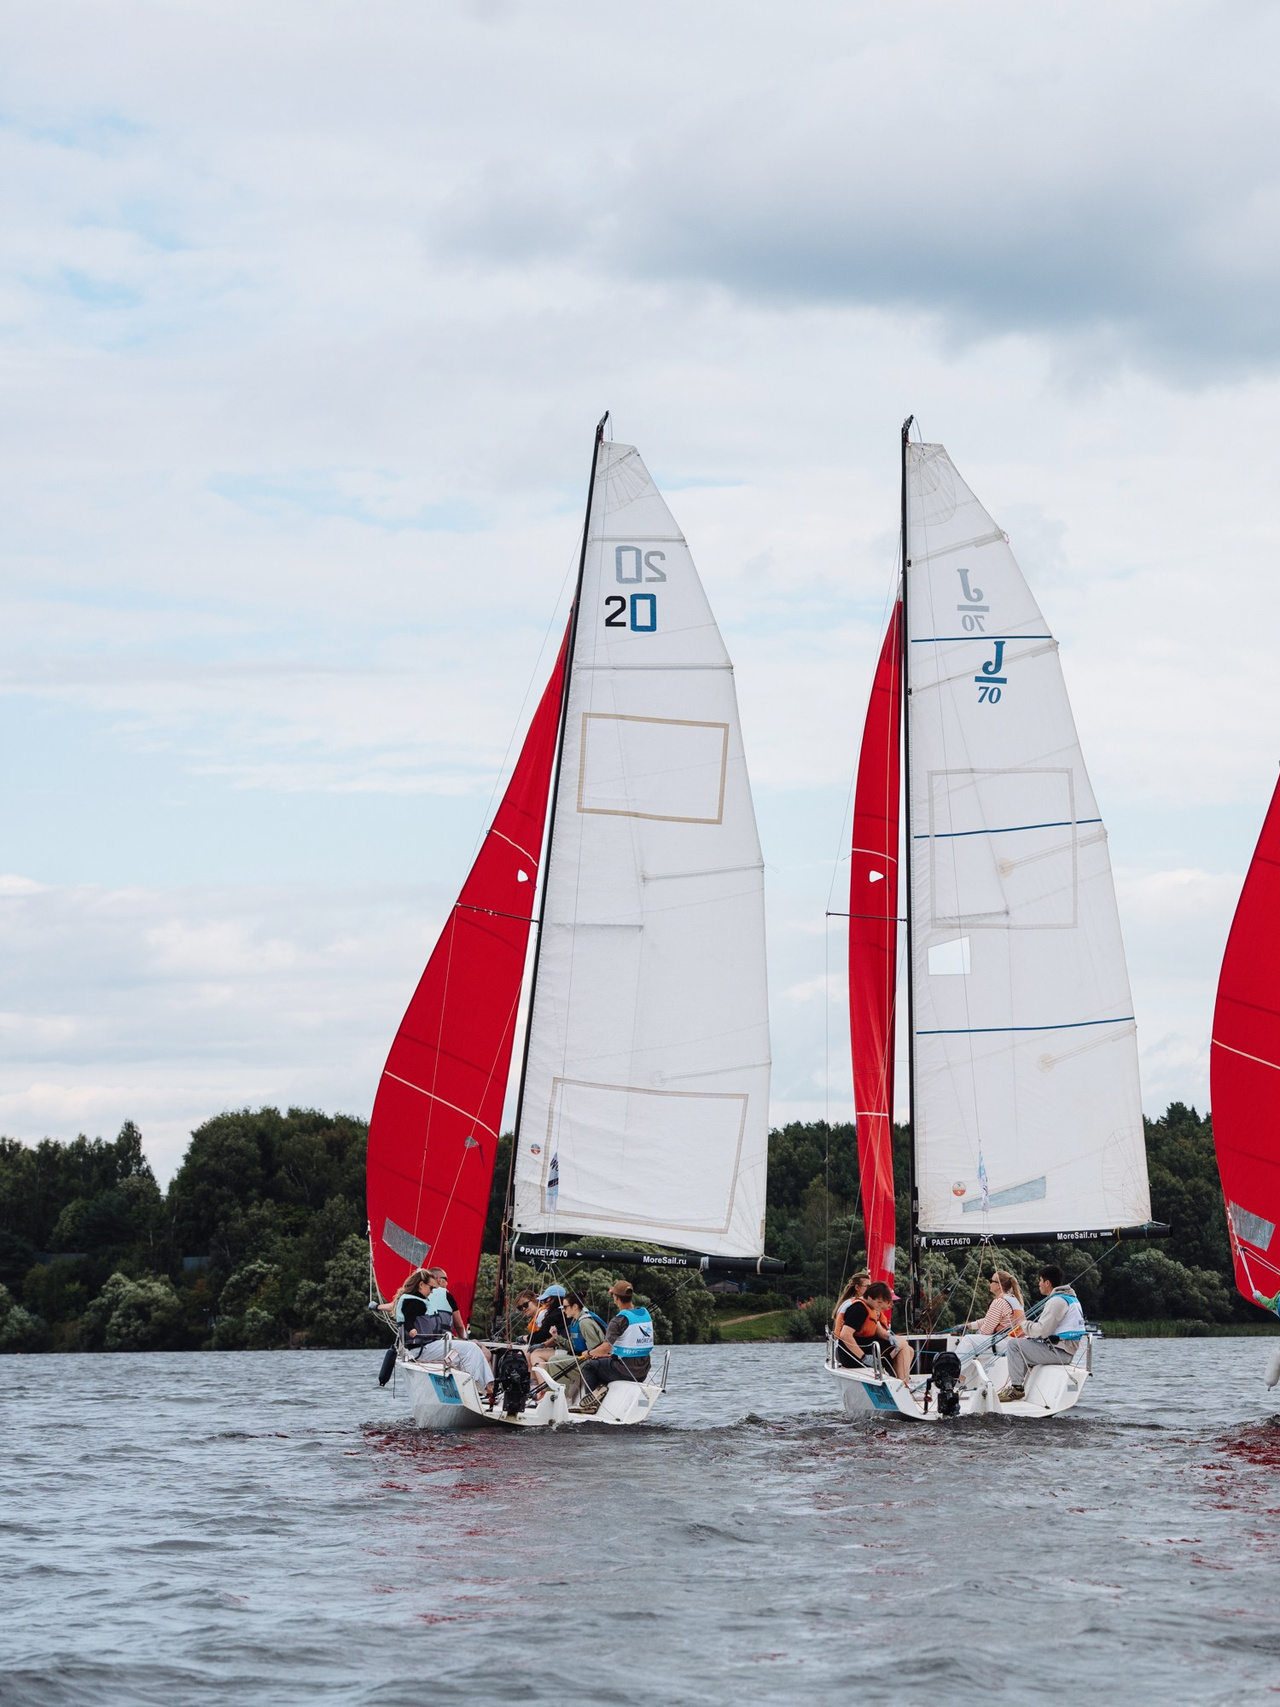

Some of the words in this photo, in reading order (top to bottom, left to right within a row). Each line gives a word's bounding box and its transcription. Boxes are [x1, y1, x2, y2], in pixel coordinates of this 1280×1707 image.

[605, 593, 657, 632] 20
[982, 641, 1006, 675] J
[978, 686, 1002, 704] 70
[1057, 1232, 1098, 1240] MoreSail.ru
[643, 1255, 687, 1265] MoreSail.ru
